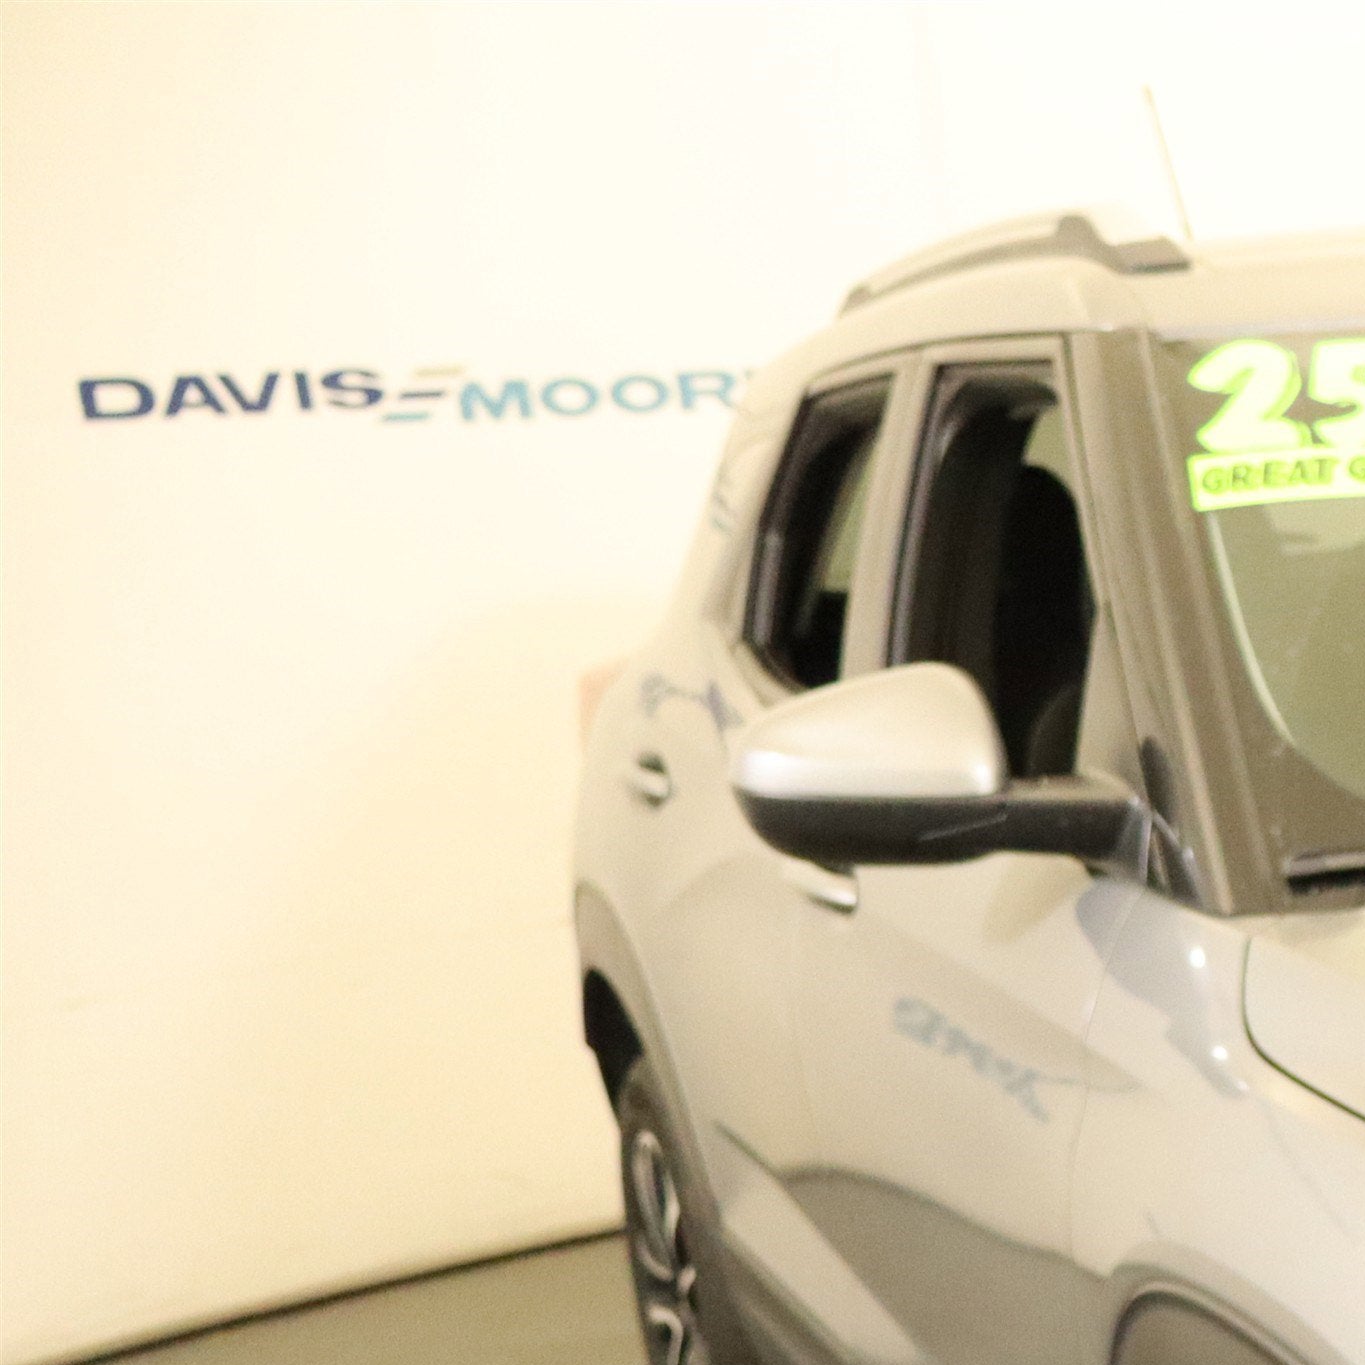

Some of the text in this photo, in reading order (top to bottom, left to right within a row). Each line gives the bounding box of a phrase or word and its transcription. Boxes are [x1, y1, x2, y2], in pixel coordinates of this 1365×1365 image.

[77, 368, 755, 423] DAVIS MOOR
[1201, 455, 1336, 494] GREAT
